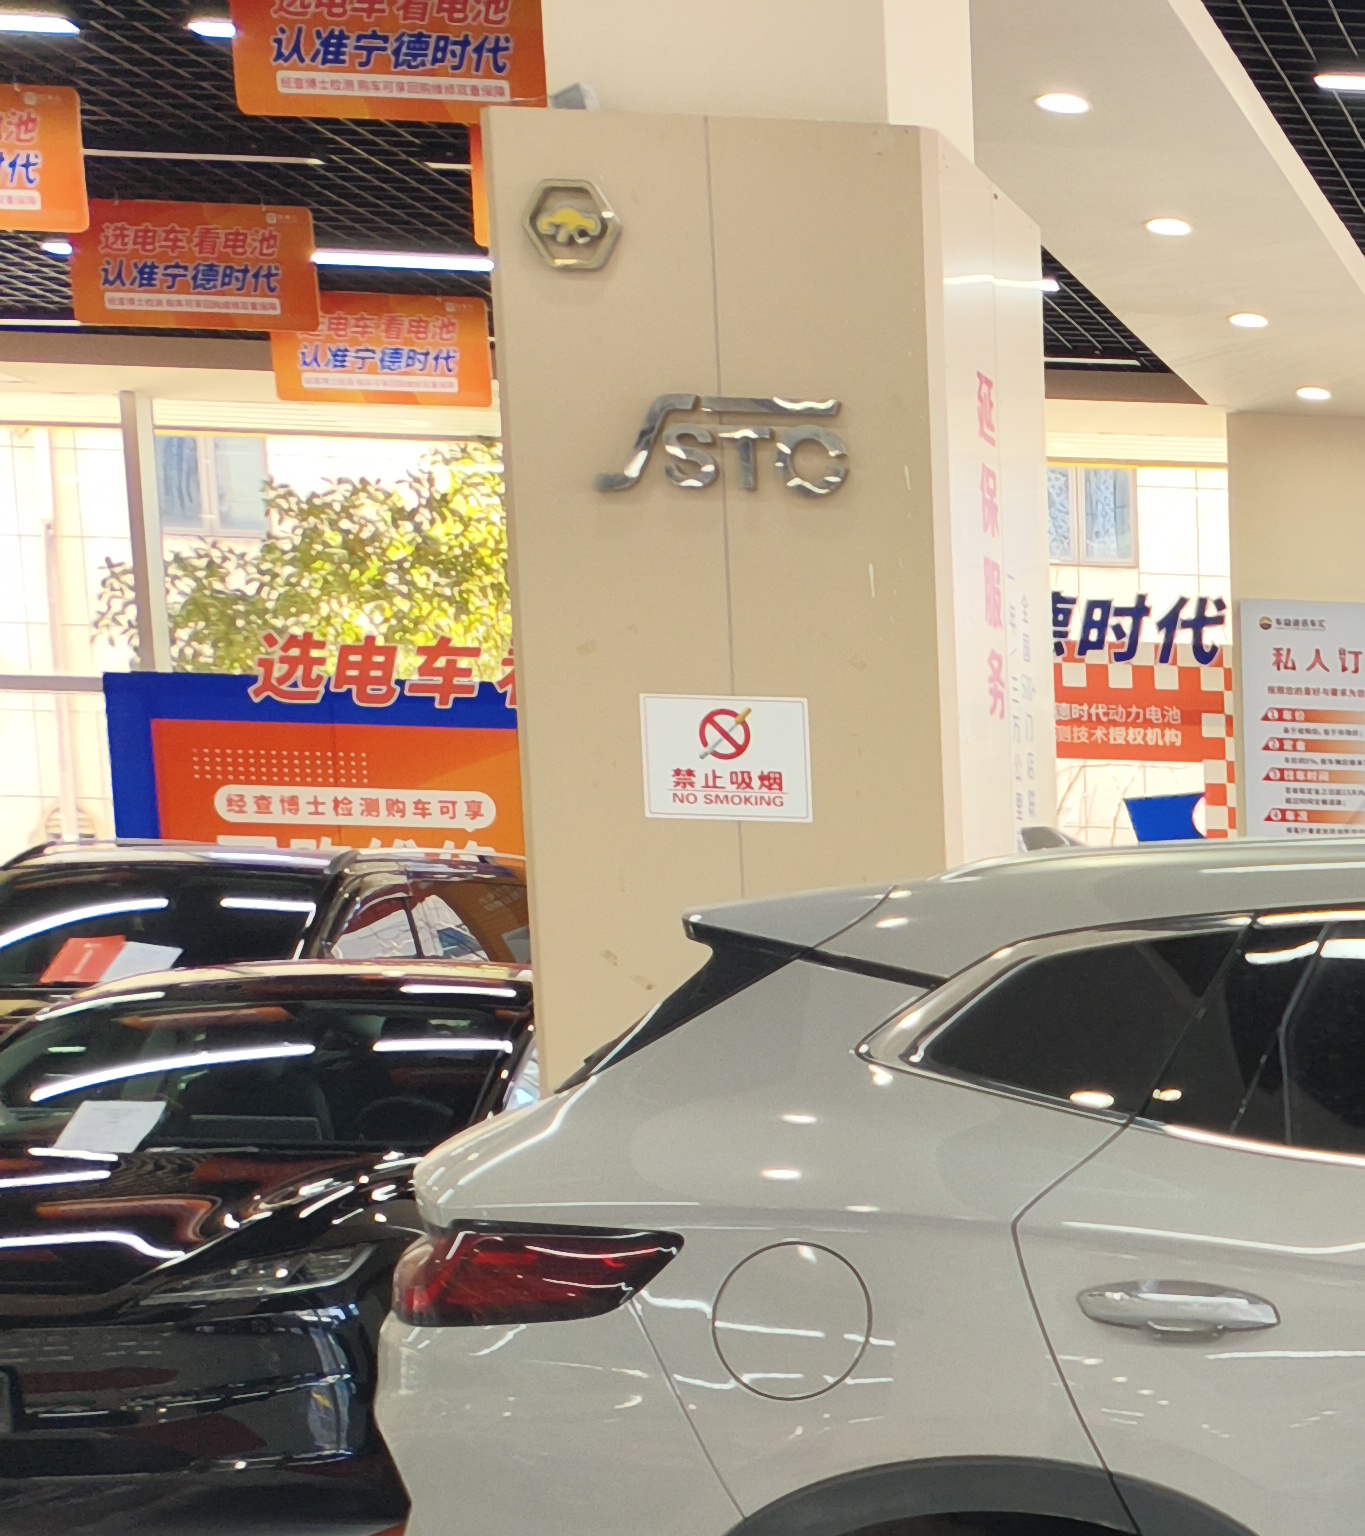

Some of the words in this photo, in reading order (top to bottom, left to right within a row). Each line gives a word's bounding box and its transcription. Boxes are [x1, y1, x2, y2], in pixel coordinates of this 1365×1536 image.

[271, 25, 513, 76] 认准宁德时代
[101, 259, 281, 294] 认准宁德时代
[300, 312, 459, 343] 电车看电池
[299, 344, 460, 374] 认准宁德时代
[976, 370, 1006, 721] 延保服务
[672, 768, 783, 791] 禁止吸烟
[226, 794, 484, 820] 经查博士检测购车可享
[672, 793, 698, 805] NO
[703, 794, 784, 807] SMOKING
